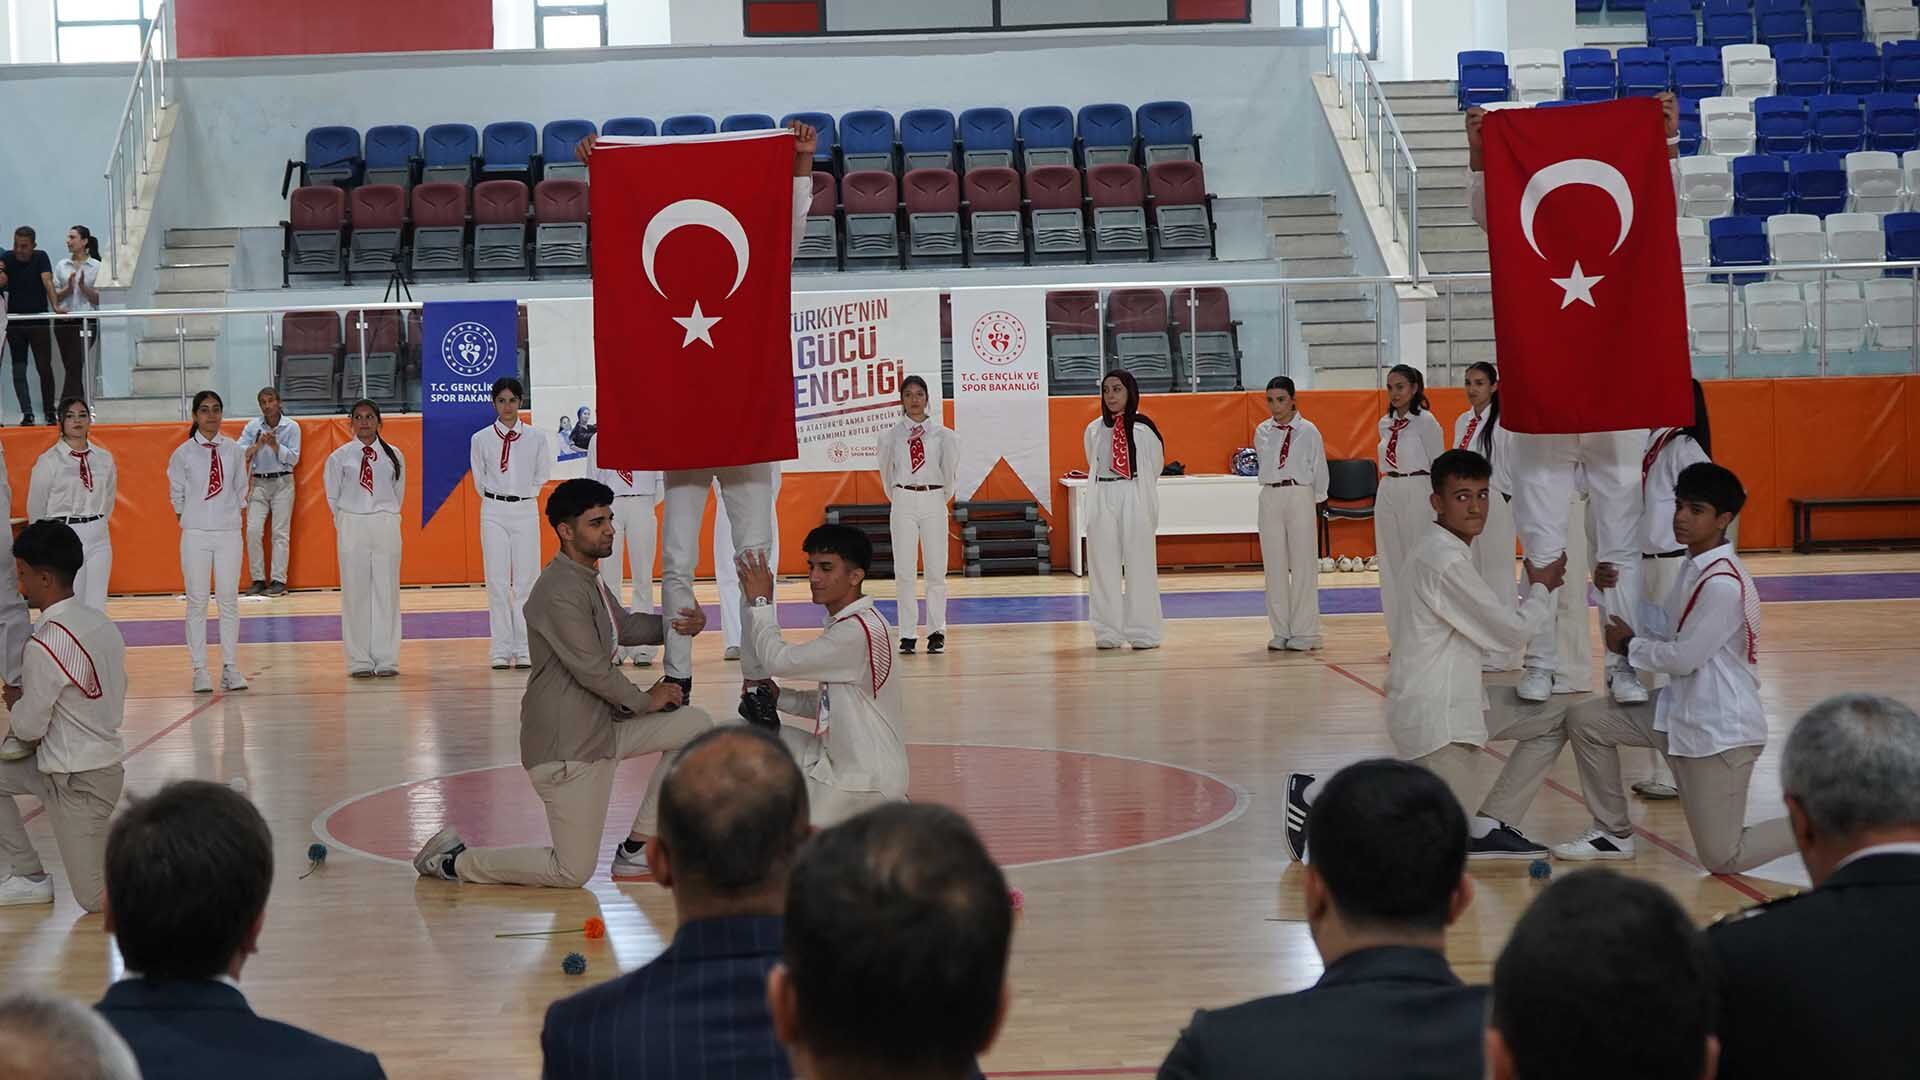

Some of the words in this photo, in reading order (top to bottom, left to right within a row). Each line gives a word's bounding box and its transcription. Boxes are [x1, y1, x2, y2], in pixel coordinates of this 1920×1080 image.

[791, 298, 888, 332] ÜRKİYE'NİN
[797, 326, 877, 369] GÜCÜ
[961, 373, 979, 381] T.C.
[981, 371, 1024, 382] GENÇLİK
[1026, 372, 1039, 380] VE
[430, 383, 449, 392] T.C.
[450, 382, 493, 393] GENÇLİK
[794, 358, 904, 408] ENÇLİĞİ
[962, 384, 987, 392] SPOR
[989, 382, 1040, 391] BAKANLIĞI
[430, 394, 456, 402] SPOR
